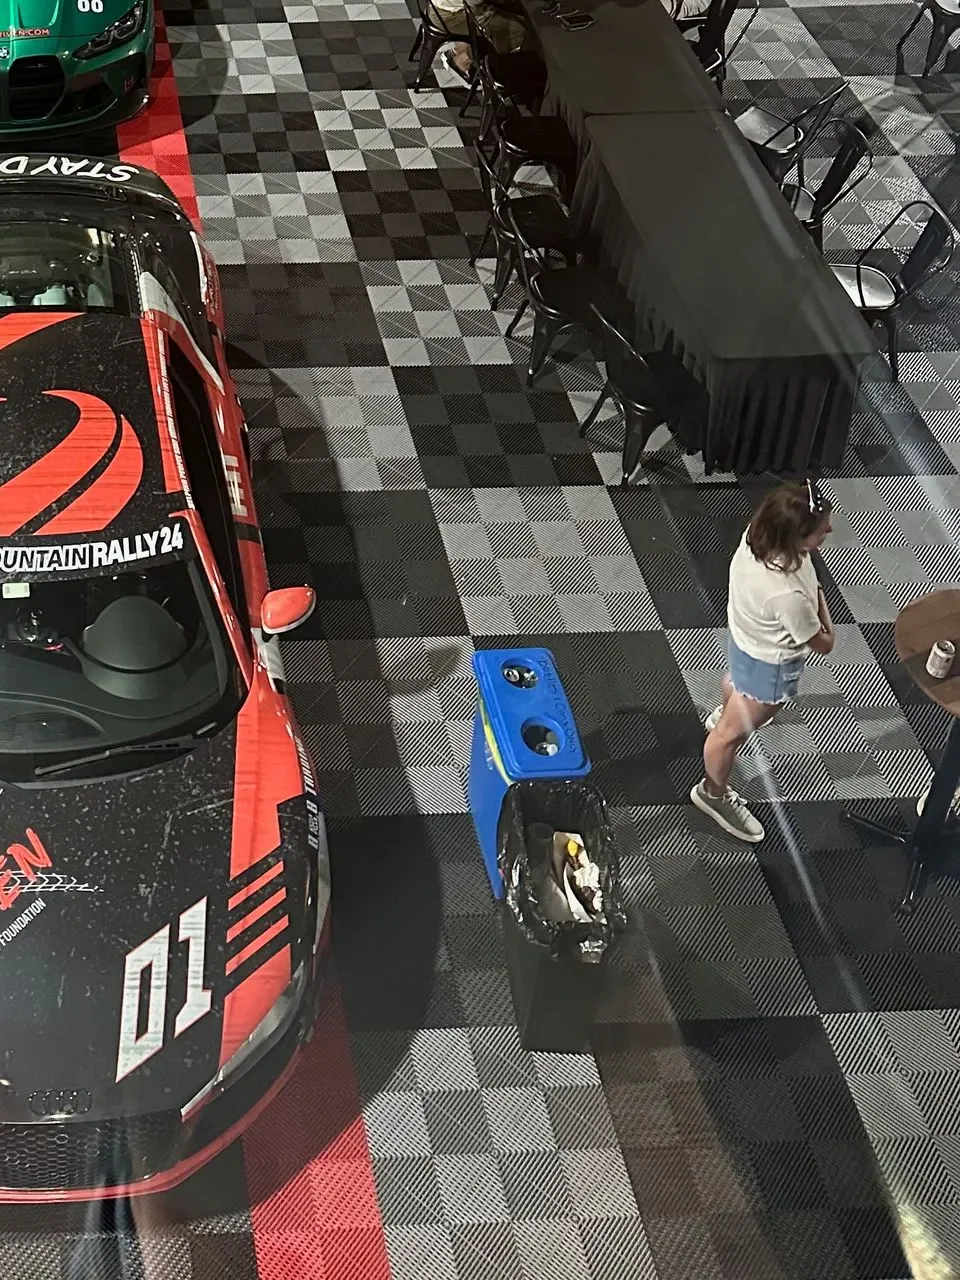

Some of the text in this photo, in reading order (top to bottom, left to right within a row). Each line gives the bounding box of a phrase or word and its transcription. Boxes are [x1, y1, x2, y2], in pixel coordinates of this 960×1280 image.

[31, 156, 140, 182] STAY
[90, 523, 184, 568] RALLY24
[115, 894, 213, 1085] 01
